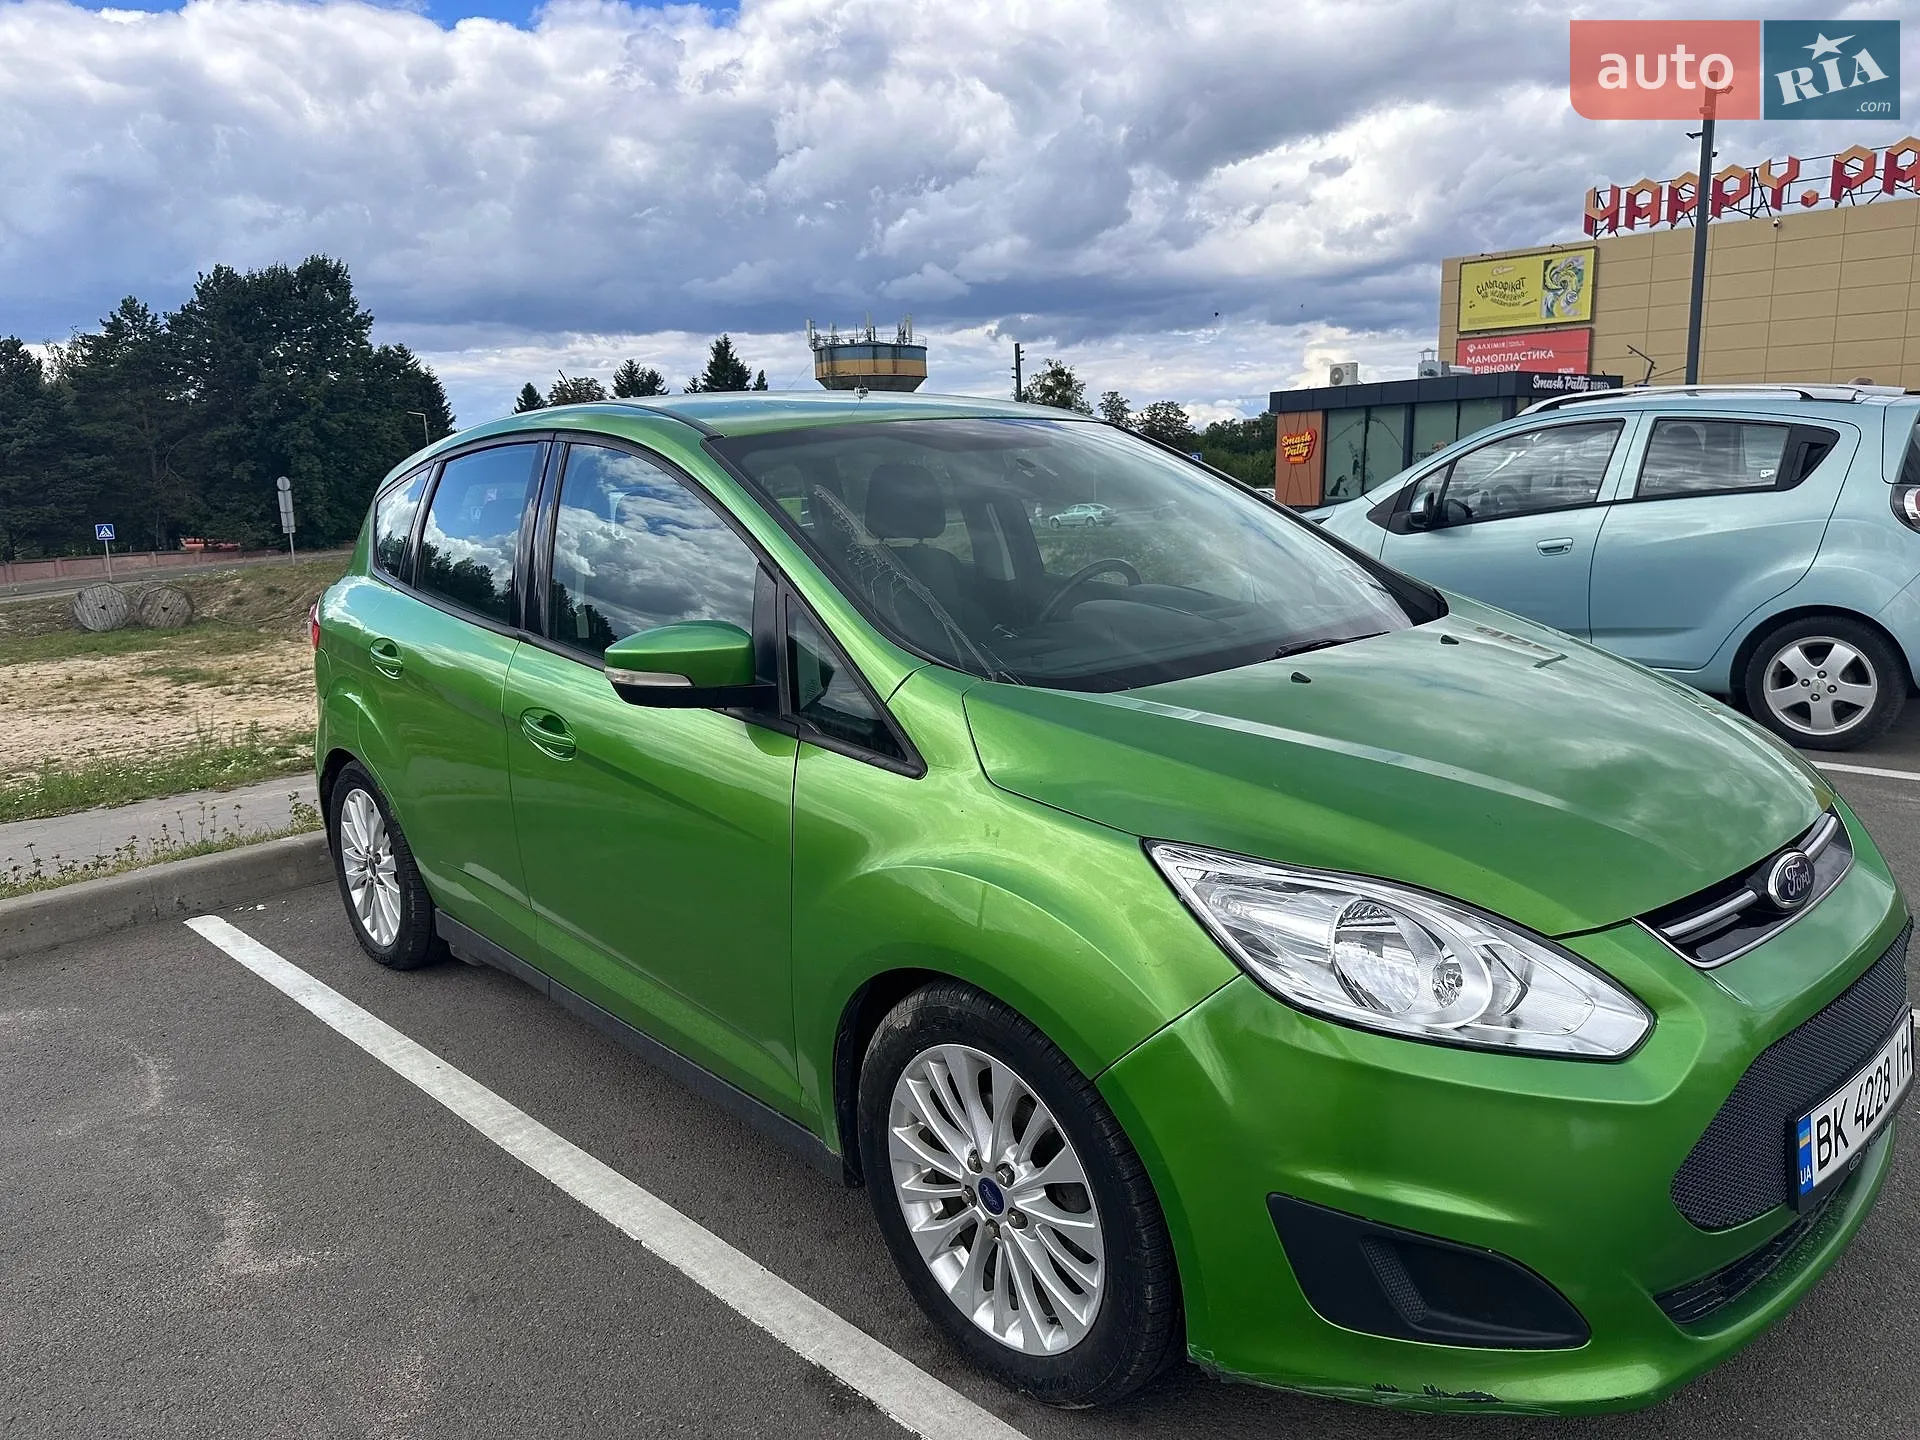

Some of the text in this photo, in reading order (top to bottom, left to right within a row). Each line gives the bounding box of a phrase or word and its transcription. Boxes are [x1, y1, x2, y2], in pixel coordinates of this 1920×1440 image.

[1466, 350, 1554, 364] МАМОПЛАСТИКА
[1474, 363, 1520, 374] РІВНОМУ
[1533, 375, 1564, 389] Smash
[1565, 376, 1590, 392] Patty
[1281, 431, 1312, 445] Smash
[1284, 443, 1310, 458] Patty
[1785, 861, 1811, 897] Ford
[1815, 1097, 1849, 1172] BK
[1854, 1055, 1891, 1133] 4228
[1800, 1166, 1812, 1185] UA
